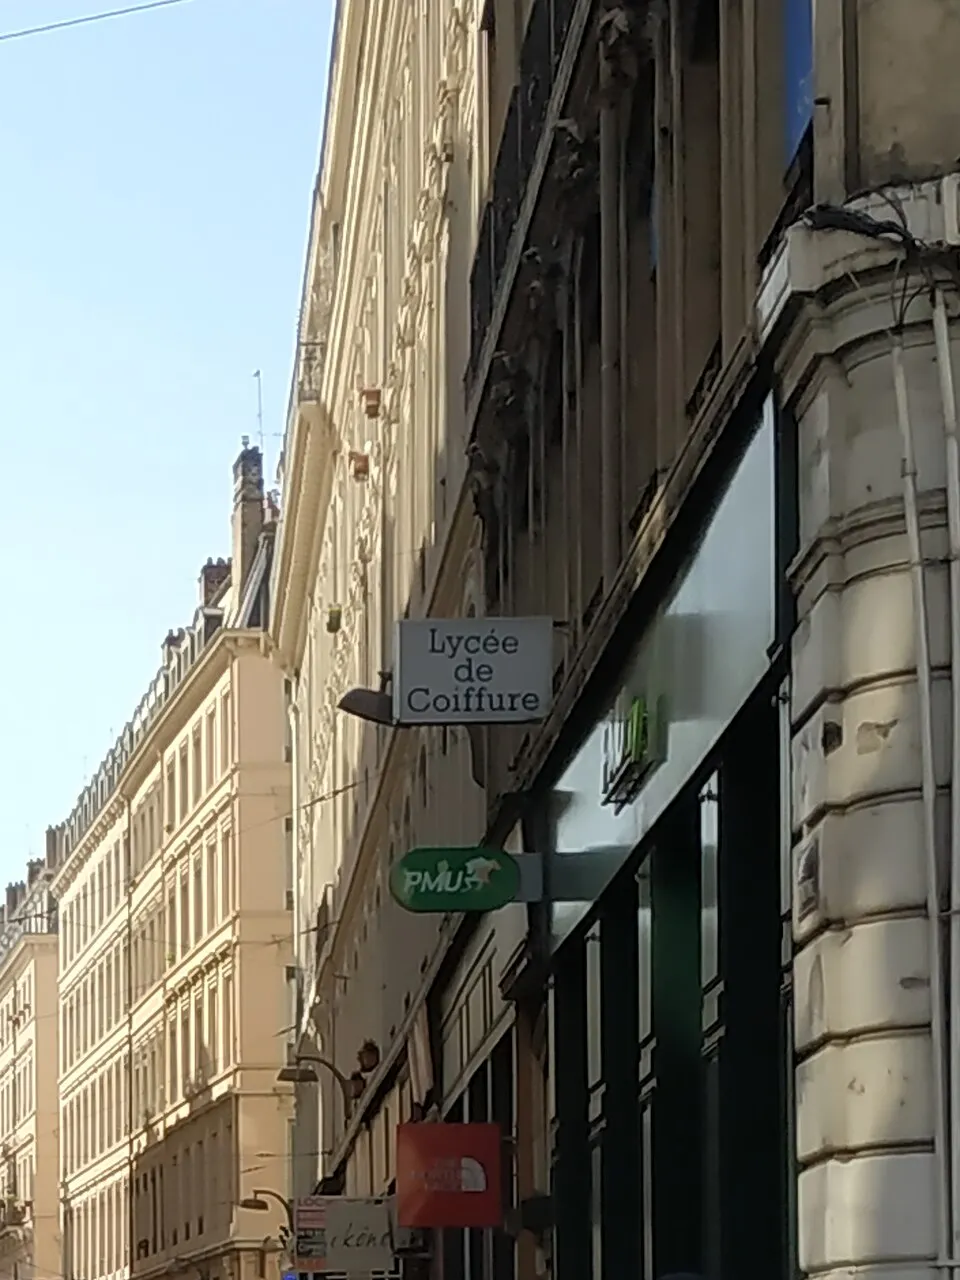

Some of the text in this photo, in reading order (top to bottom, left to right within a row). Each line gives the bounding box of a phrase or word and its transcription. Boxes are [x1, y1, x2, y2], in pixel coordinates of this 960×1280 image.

[428, 627, 519, 659] Lycée
[453, 659, 494, 683] de
[407, 688, 540, 713] Coiffure
[403, 869, 464, 893] PMU
